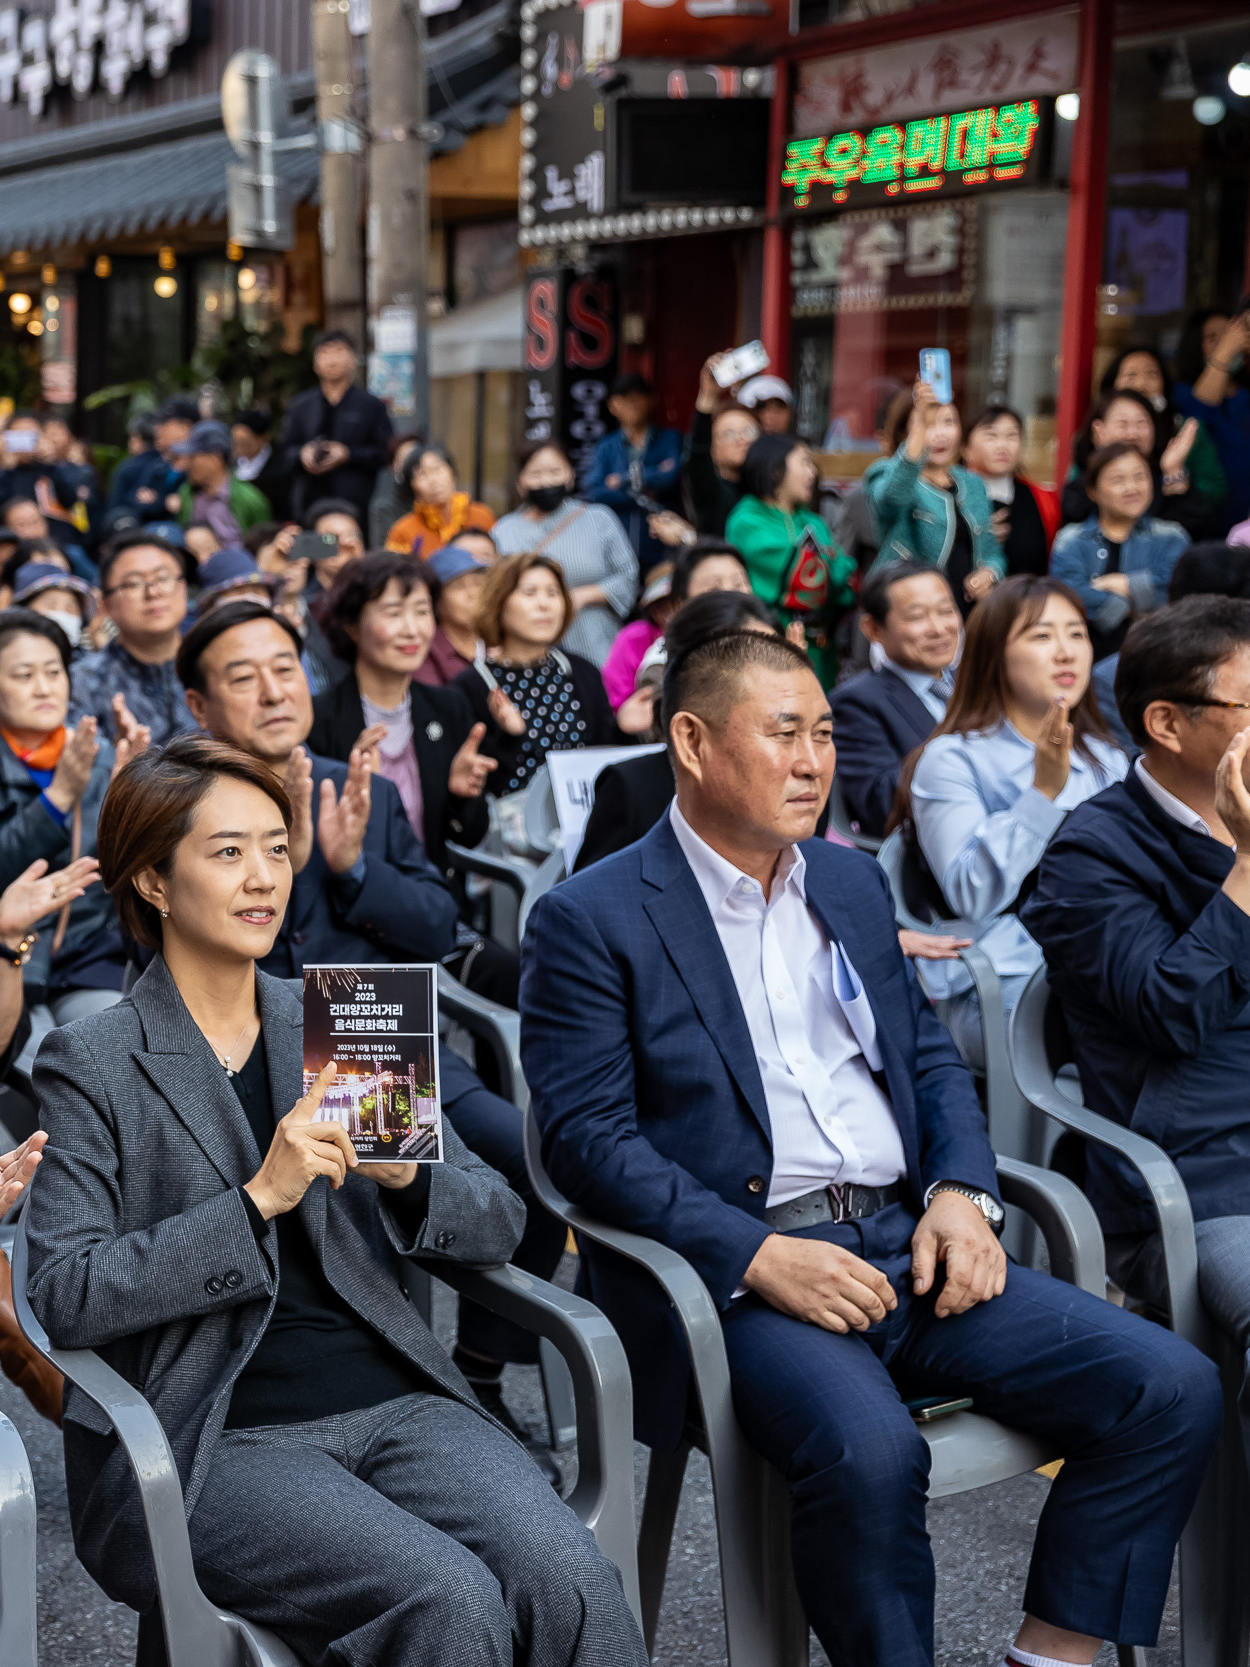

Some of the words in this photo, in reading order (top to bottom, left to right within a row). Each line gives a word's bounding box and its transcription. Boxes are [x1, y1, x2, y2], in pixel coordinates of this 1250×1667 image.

[541, 151, 604, 213] 노래
[526, 277, 559, 371] S
[355, 992, 376, 1001] 2023
[330, 1004, 403, 1016] 건대양꼬치거리
[335, 1019, 398, 1031] 음식문화축제
[337, 1044, 356, 1052] 2023년
[371, 1044, 383, 1052] 18일
